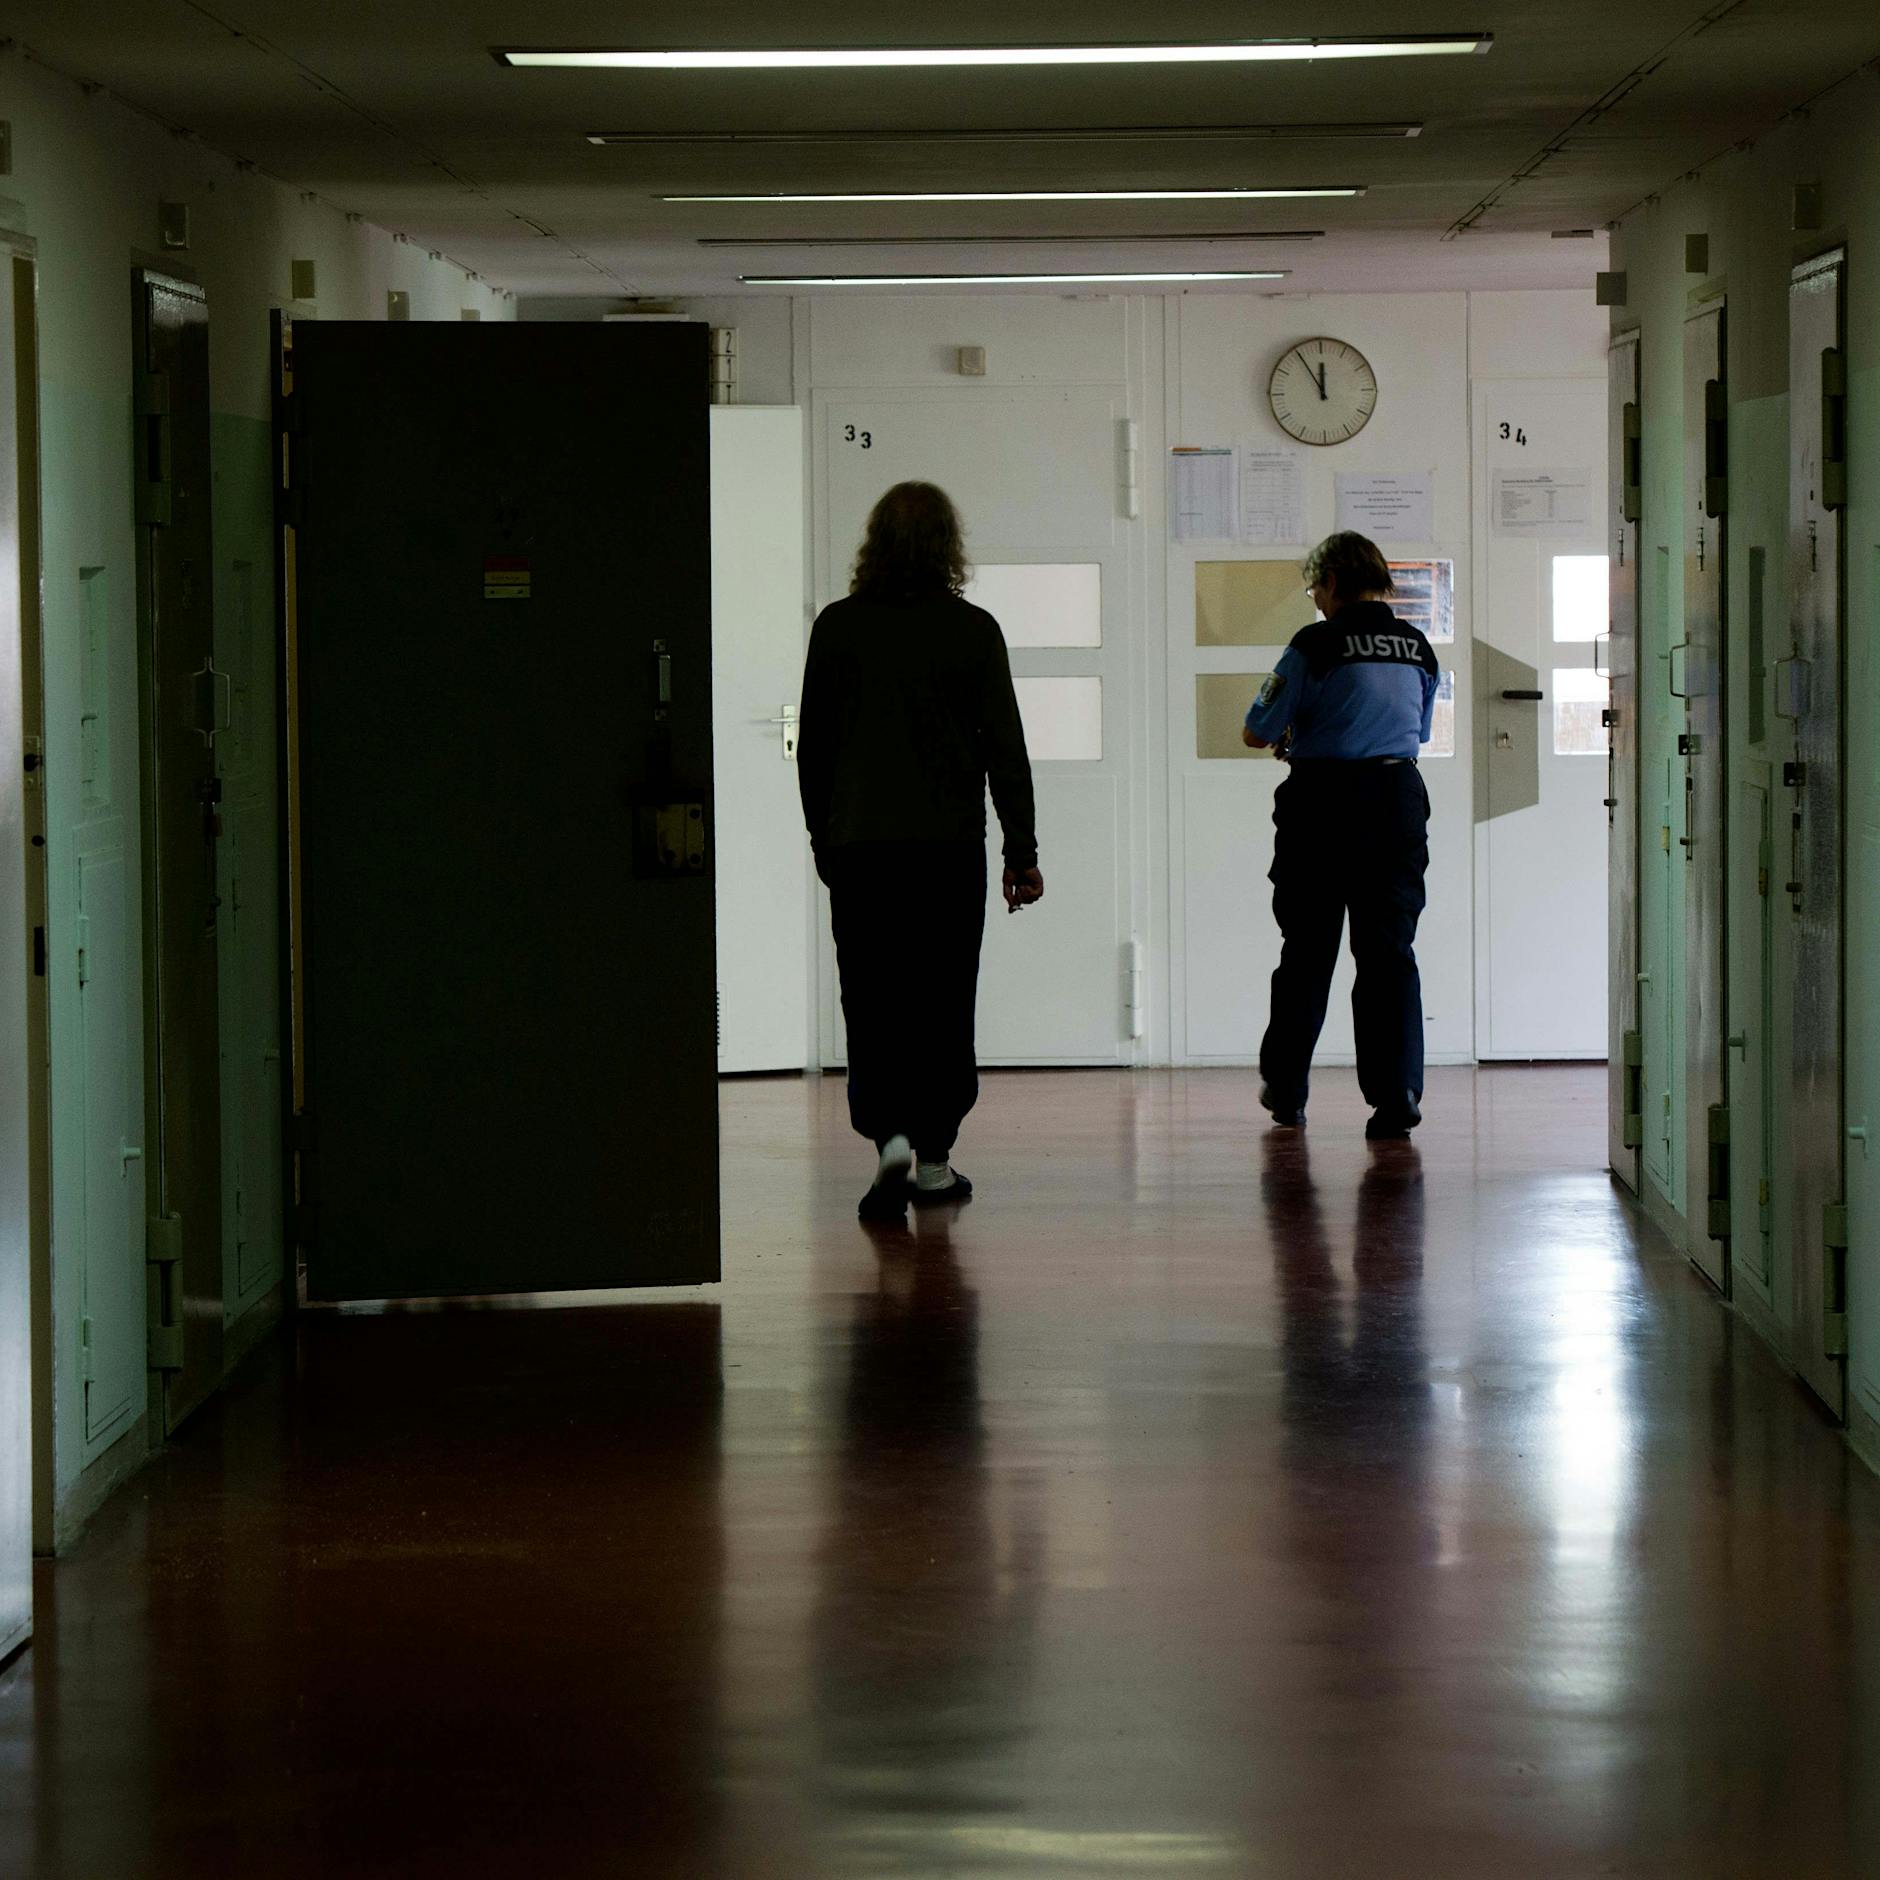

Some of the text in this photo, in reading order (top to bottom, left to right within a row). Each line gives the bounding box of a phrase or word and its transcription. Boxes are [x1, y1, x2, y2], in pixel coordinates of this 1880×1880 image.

[844, 424, 872, 449] 33
[1499, 422, 1527, 446] 34
[1343, 634, 1423, 661] JUSTIZ
